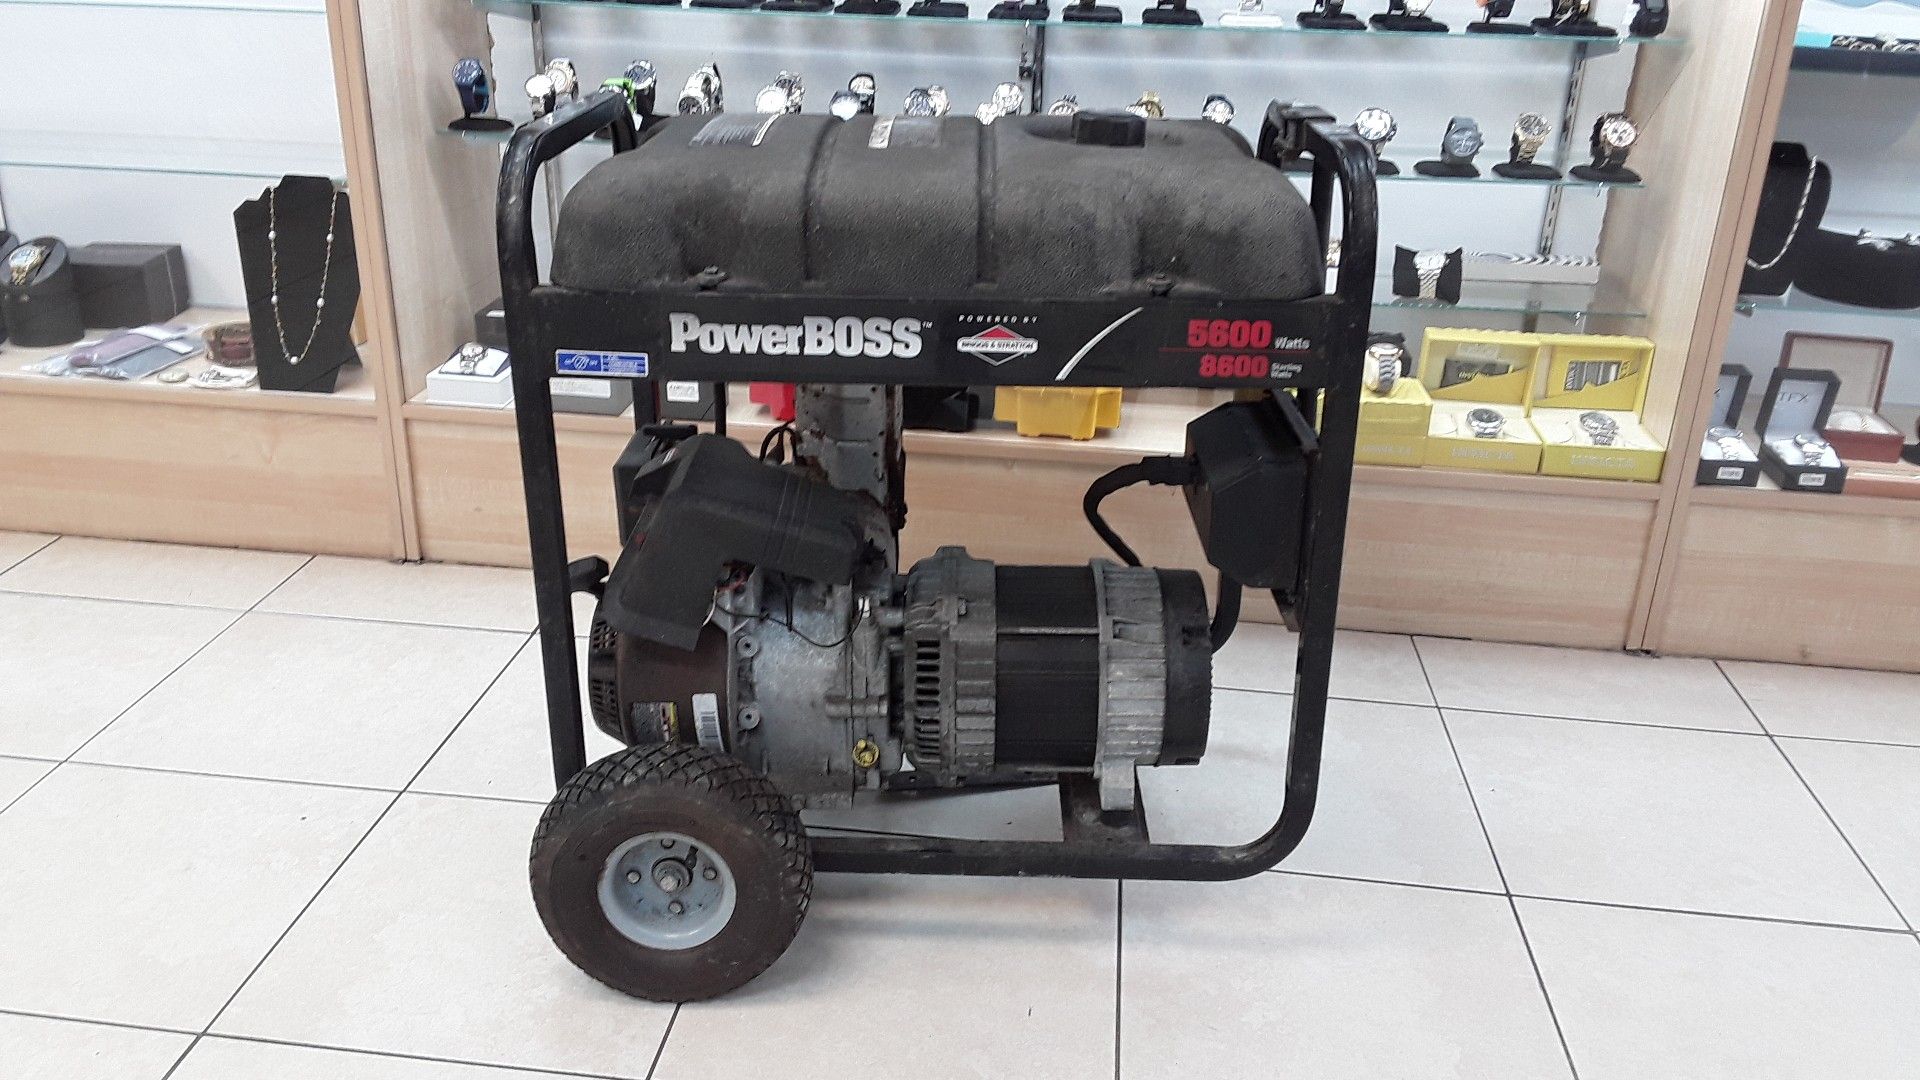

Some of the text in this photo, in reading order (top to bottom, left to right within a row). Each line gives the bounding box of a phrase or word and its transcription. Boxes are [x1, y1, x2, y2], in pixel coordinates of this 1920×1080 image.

[958, 314, 1018, 324] POWERED
[669, 311, 923, 359] PowerBOSS
[1187, 319, 1311, 350] 5600 Watts
[1200, 354, 1269, 378] 8600
